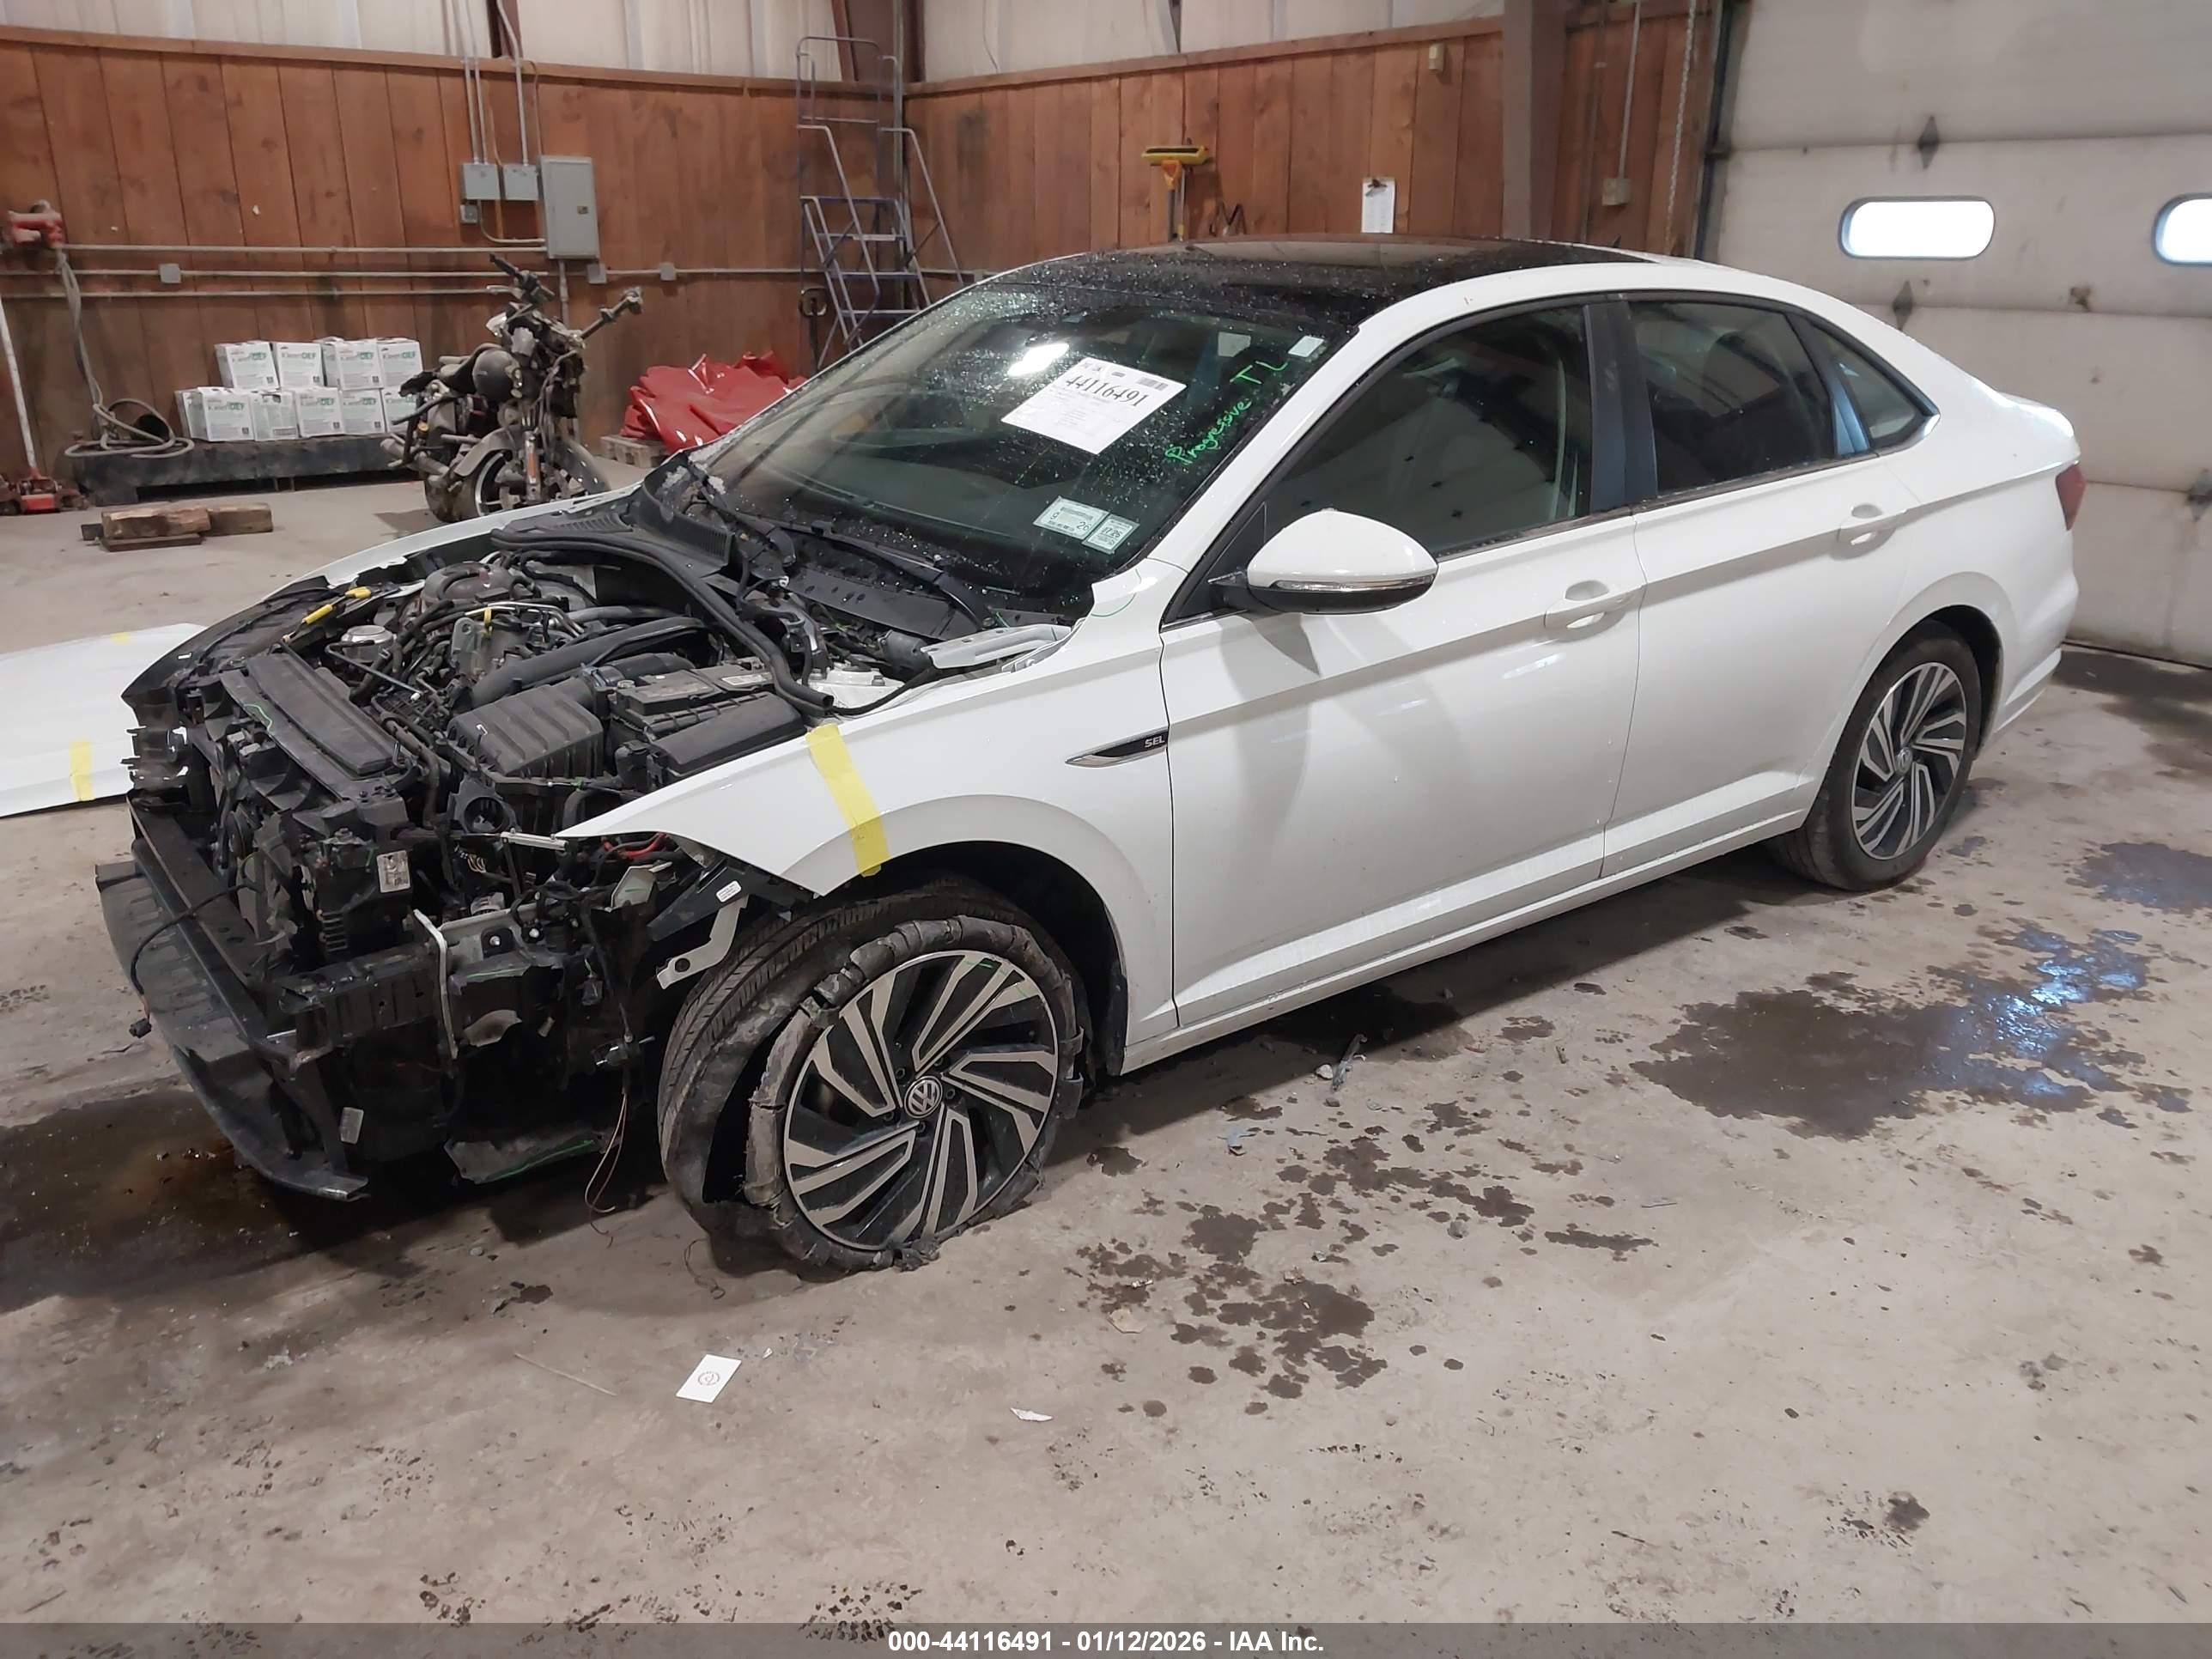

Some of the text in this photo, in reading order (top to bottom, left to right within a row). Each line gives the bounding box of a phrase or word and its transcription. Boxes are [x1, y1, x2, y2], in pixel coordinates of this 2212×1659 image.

[1066, 375, 1149, 406] 44116491
[1164, 398, 1252, 465] Progressive
[1144, 735, 1165, 748] SEL
